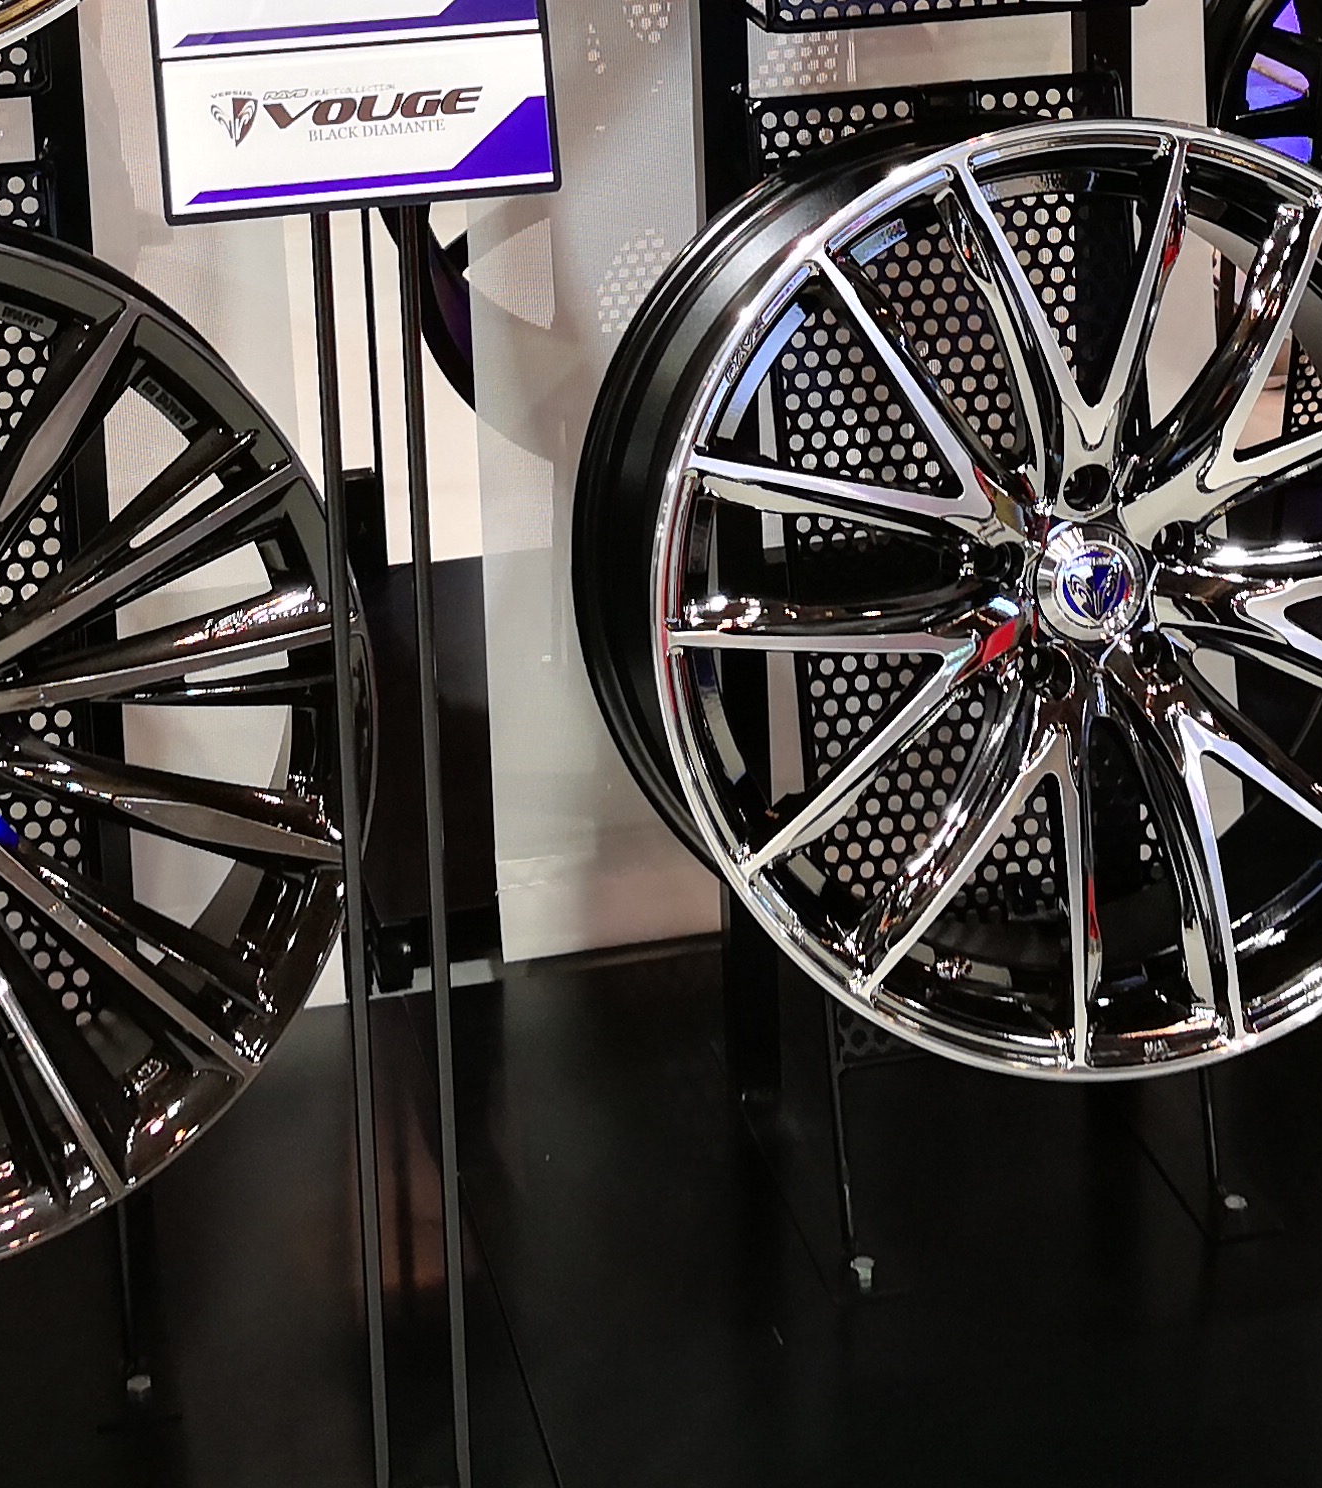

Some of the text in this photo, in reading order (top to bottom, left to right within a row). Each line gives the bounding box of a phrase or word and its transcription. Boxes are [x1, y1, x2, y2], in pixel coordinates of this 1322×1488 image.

[211, 90, 253, 99] VERSUS
[263, 86, 484, 129] VOUGE
[308, 118, 446, 142] BLACK DIAMANTE
